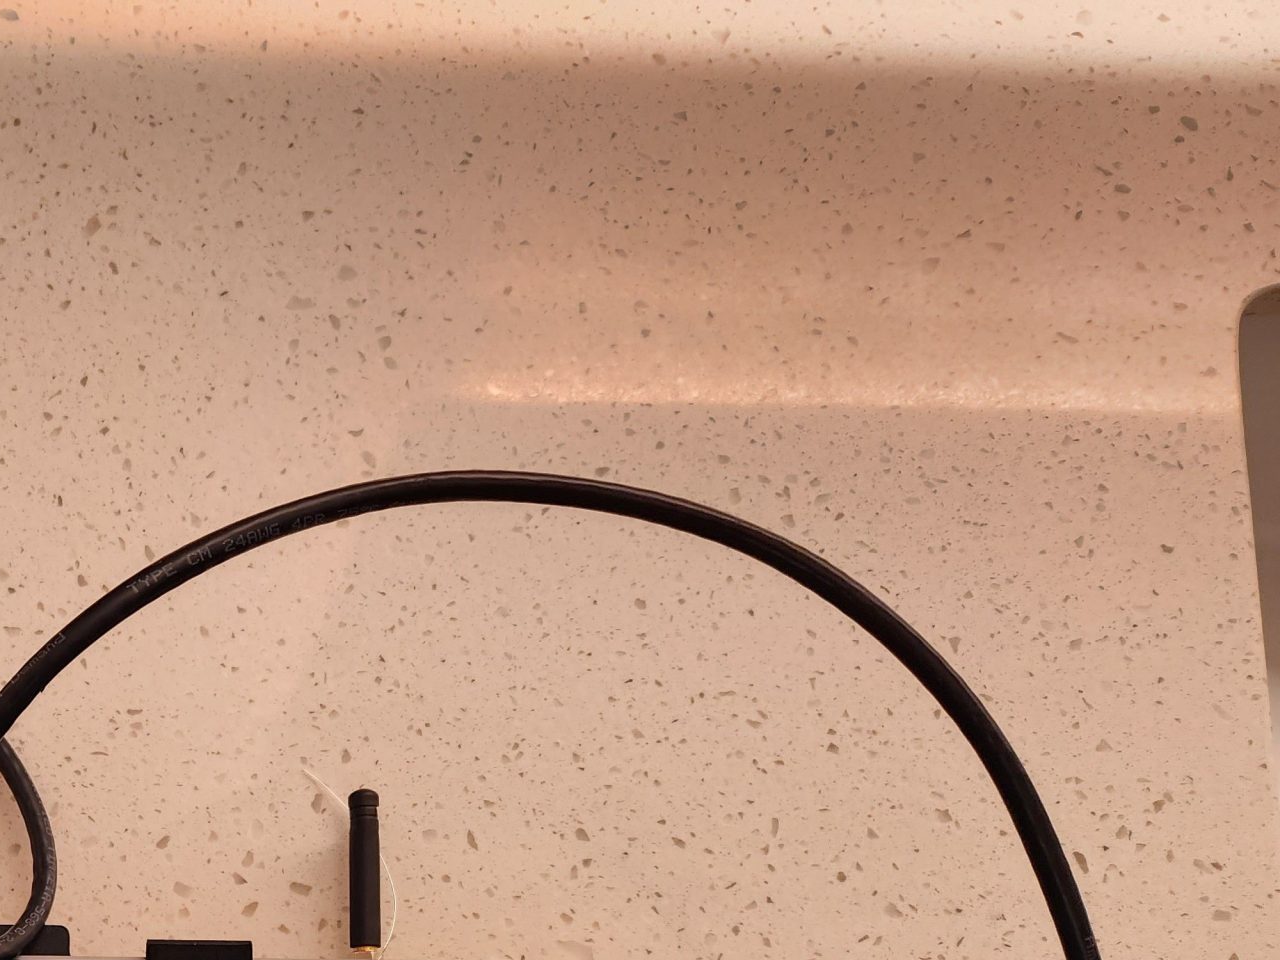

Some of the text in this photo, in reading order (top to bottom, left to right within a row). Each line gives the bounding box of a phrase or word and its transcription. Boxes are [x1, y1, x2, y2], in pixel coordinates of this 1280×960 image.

[126, 561, 177, 594] TYPE
[185, 545, 213, 567] CM
[223, 522, 281, 553] 24AWG
